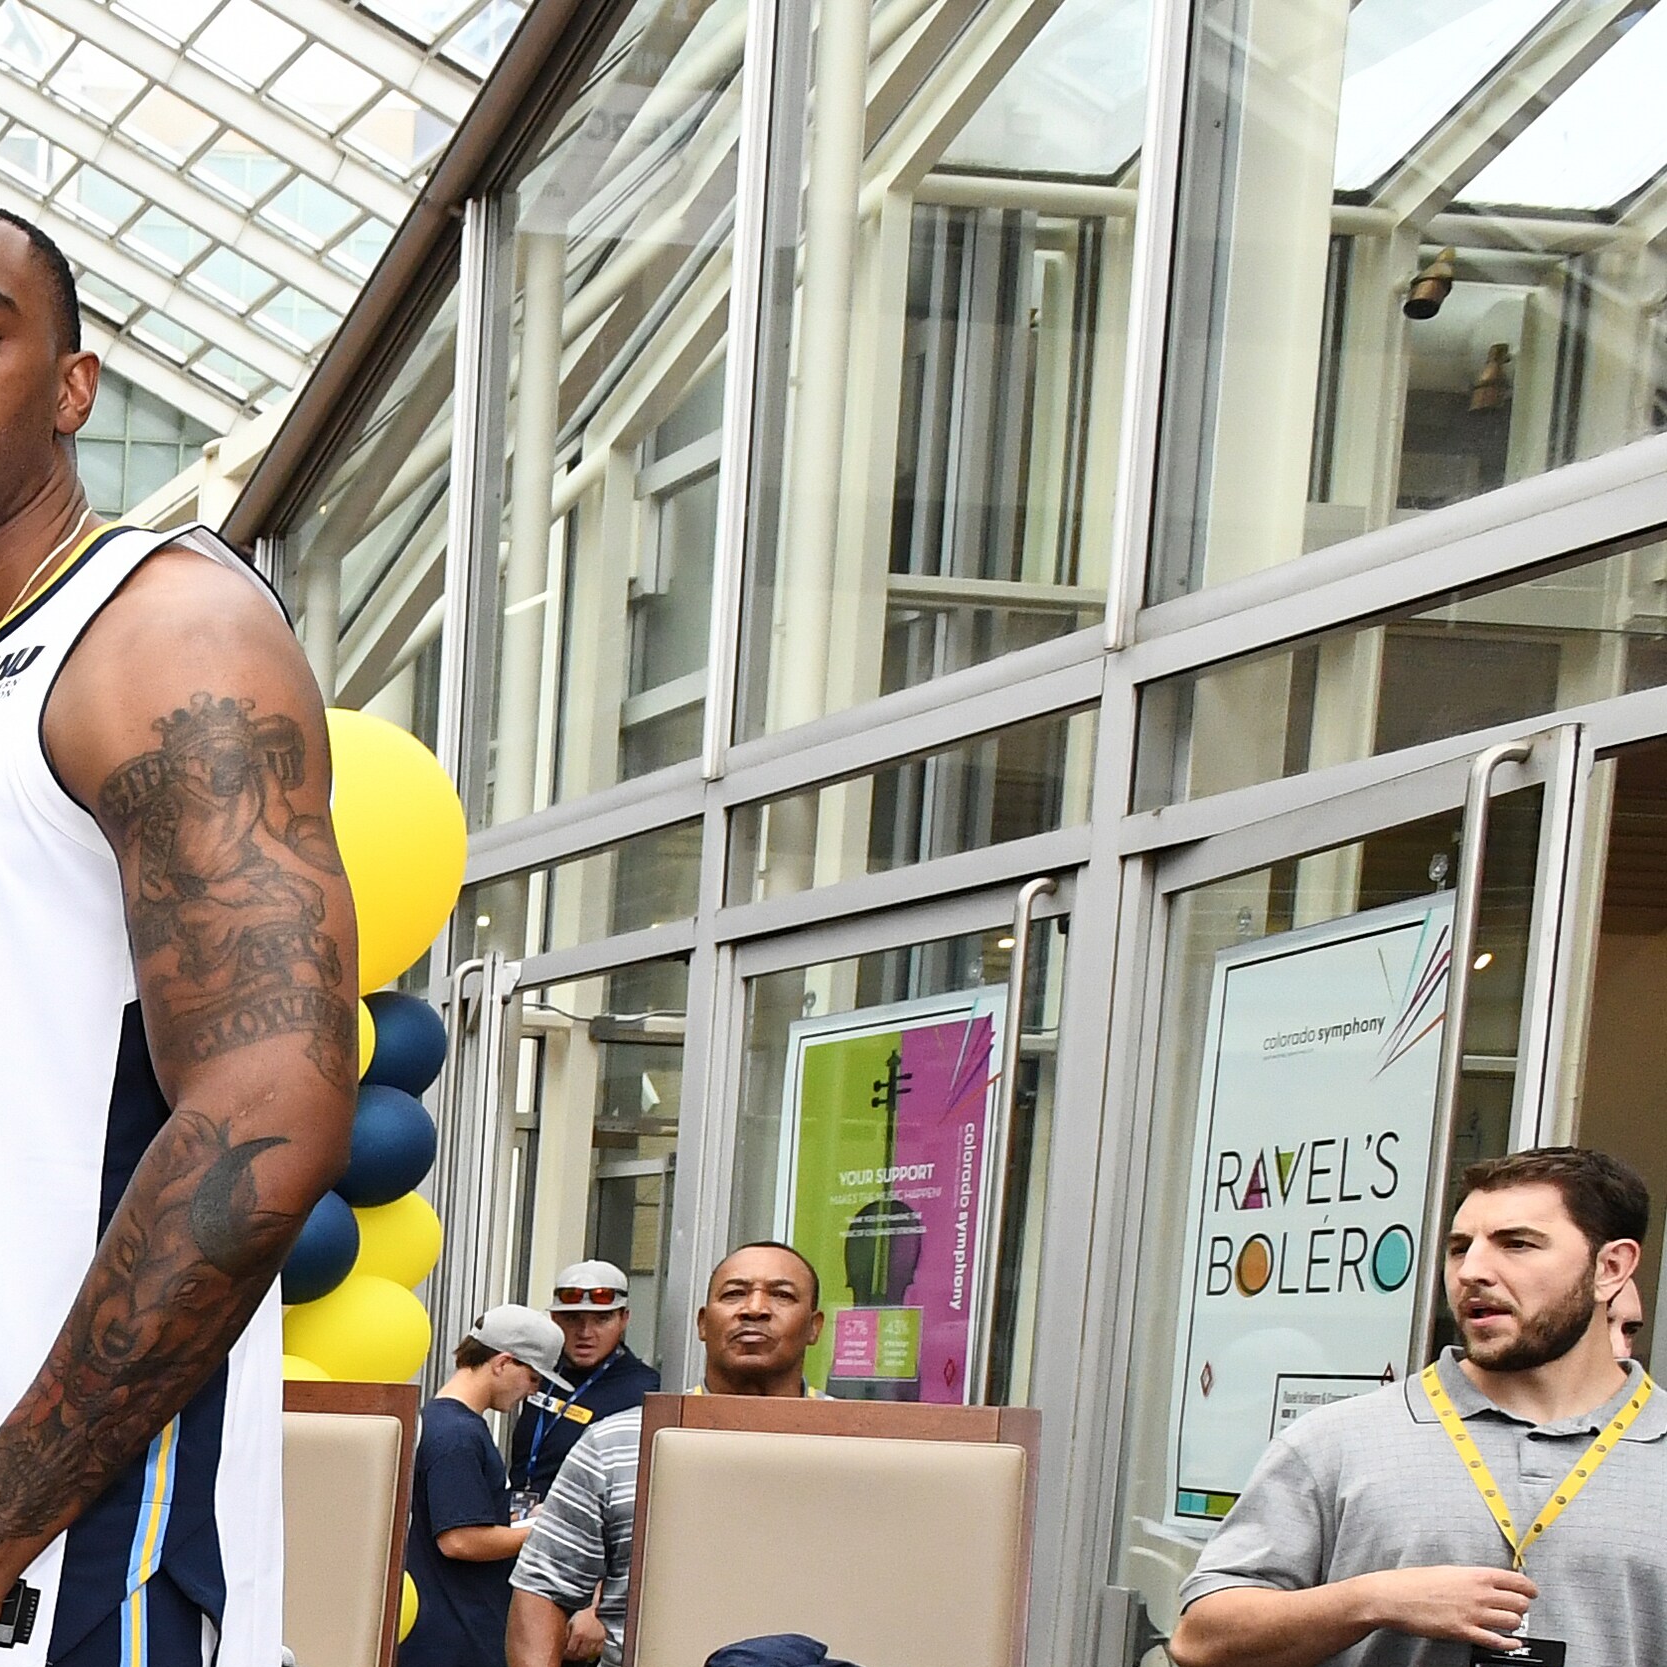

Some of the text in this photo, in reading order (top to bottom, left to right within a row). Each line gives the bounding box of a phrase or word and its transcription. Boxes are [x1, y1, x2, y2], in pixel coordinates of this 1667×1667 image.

[1263, 1016, 1386, 1050] colorado symphony
[839, 1163, 935, 1186] YOUR SUPPORT
[960, 1123, 976, 1208] colorado
[1214, 1130, 1400, 1213] RAVEL'S
[949, 1211, 969, 1311] symphony
[1205, 1213, 1414, 1298] BOLÉRO
